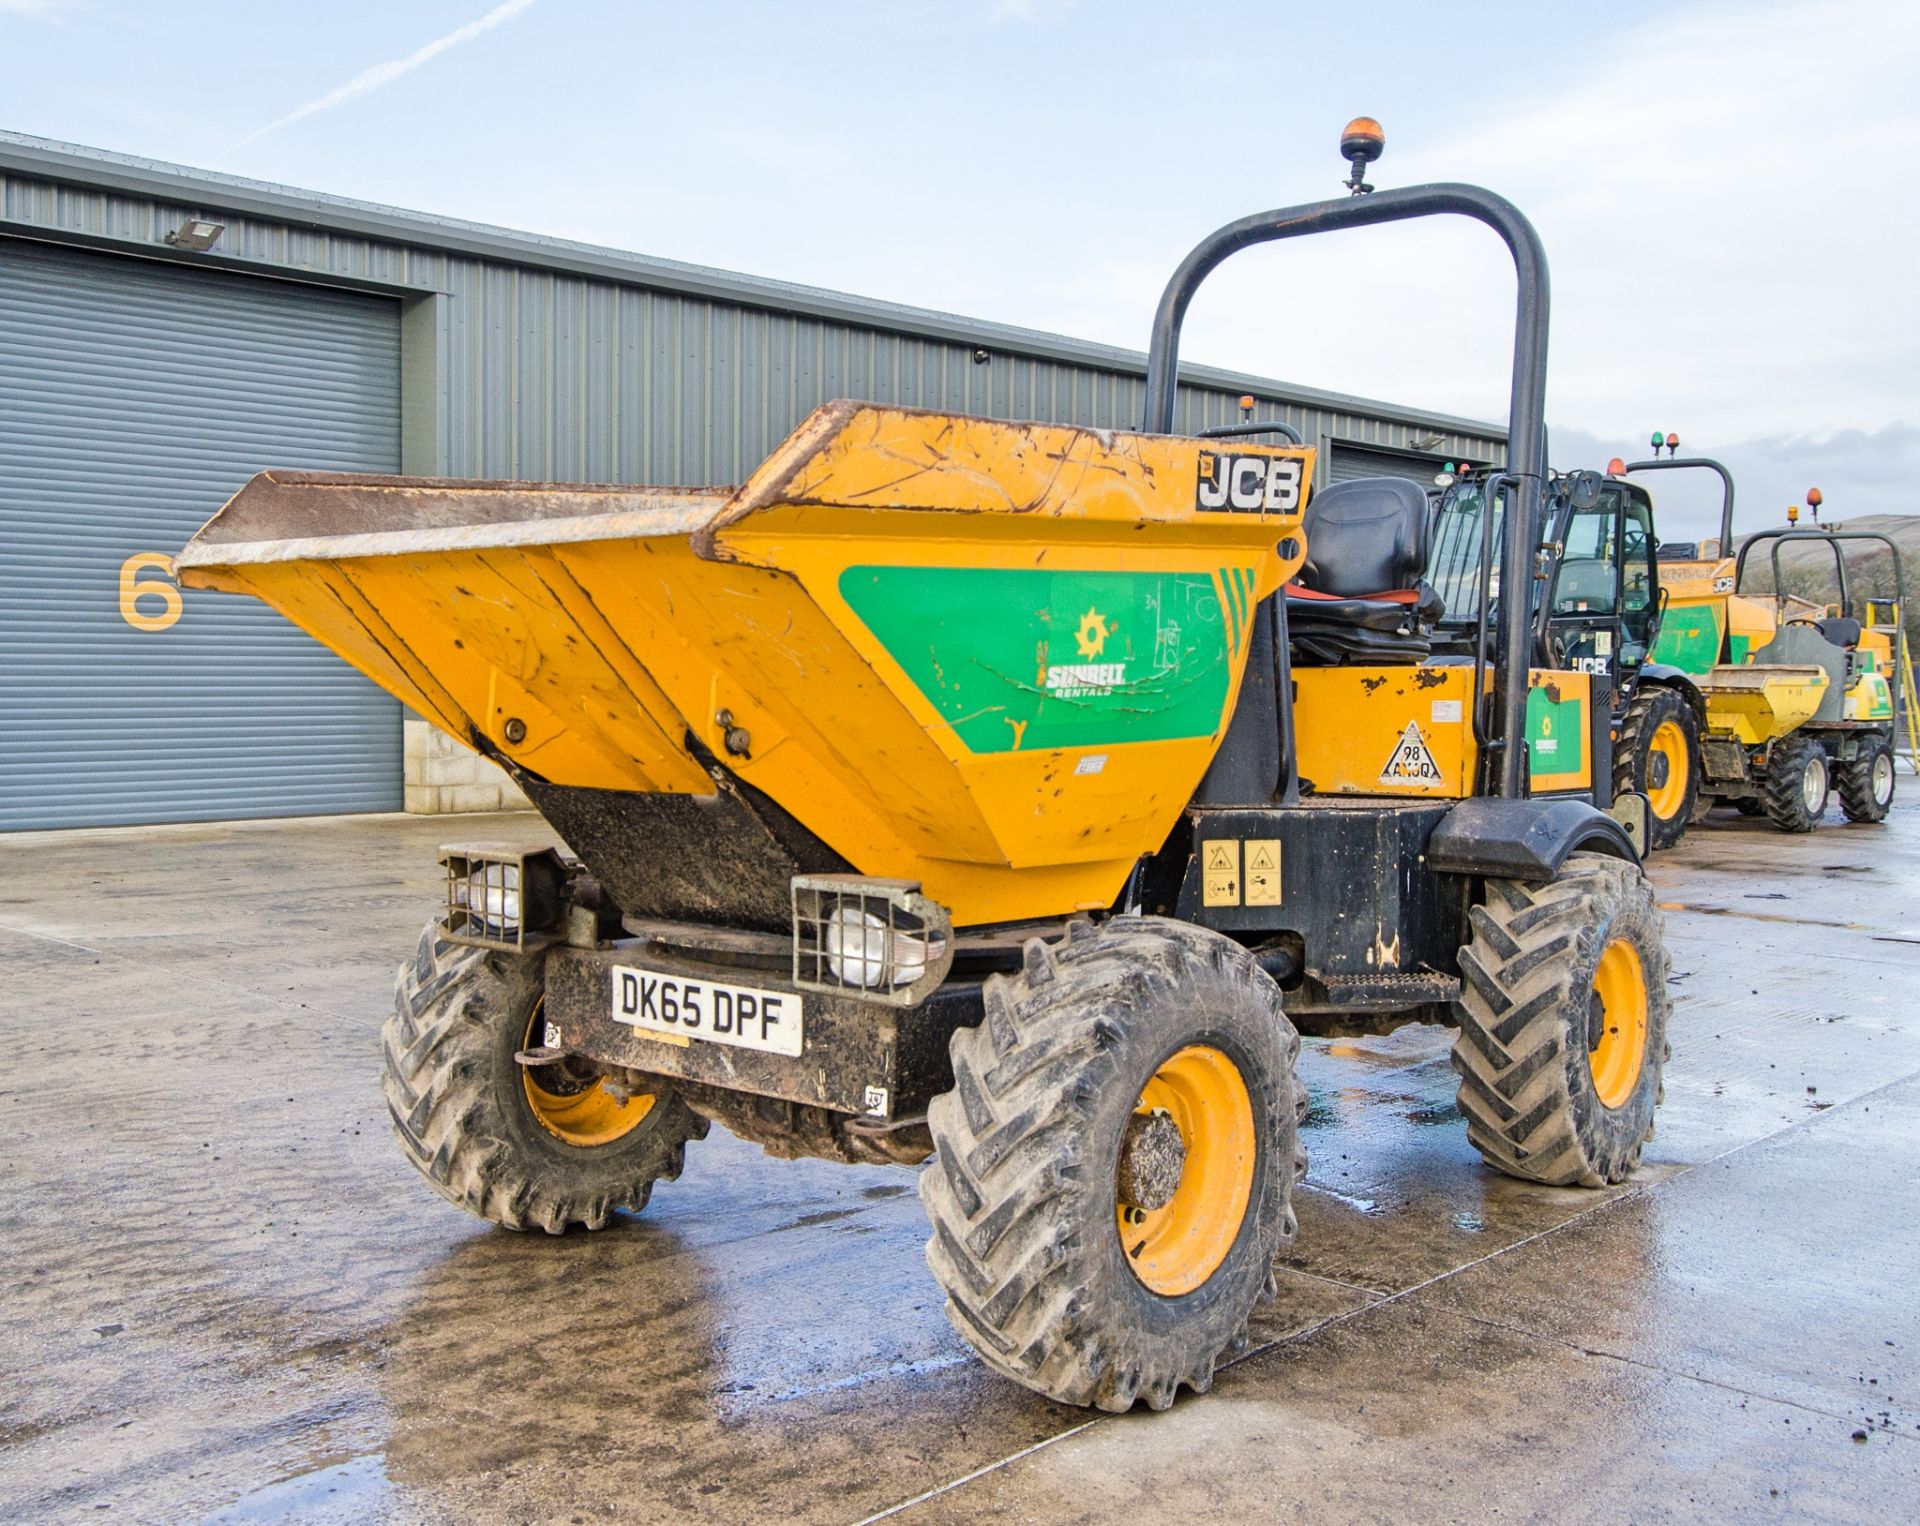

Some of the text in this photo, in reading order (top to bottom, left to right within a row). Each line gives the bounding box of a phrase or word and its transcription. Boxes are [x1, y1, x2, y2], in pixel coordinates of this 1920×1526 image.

[1199, 456, 1301, 510] JCB
[119, 552, 183, 632] 6
[1046, 663, 1126, 688] SUNBELT
[1572, 657, 1607, 676] JCB
[1055, 687, 1113, 698] RENTALS
[1404, 746, 1420, 761] 98
[622, 973, 782, 1040] DK65 DPF
